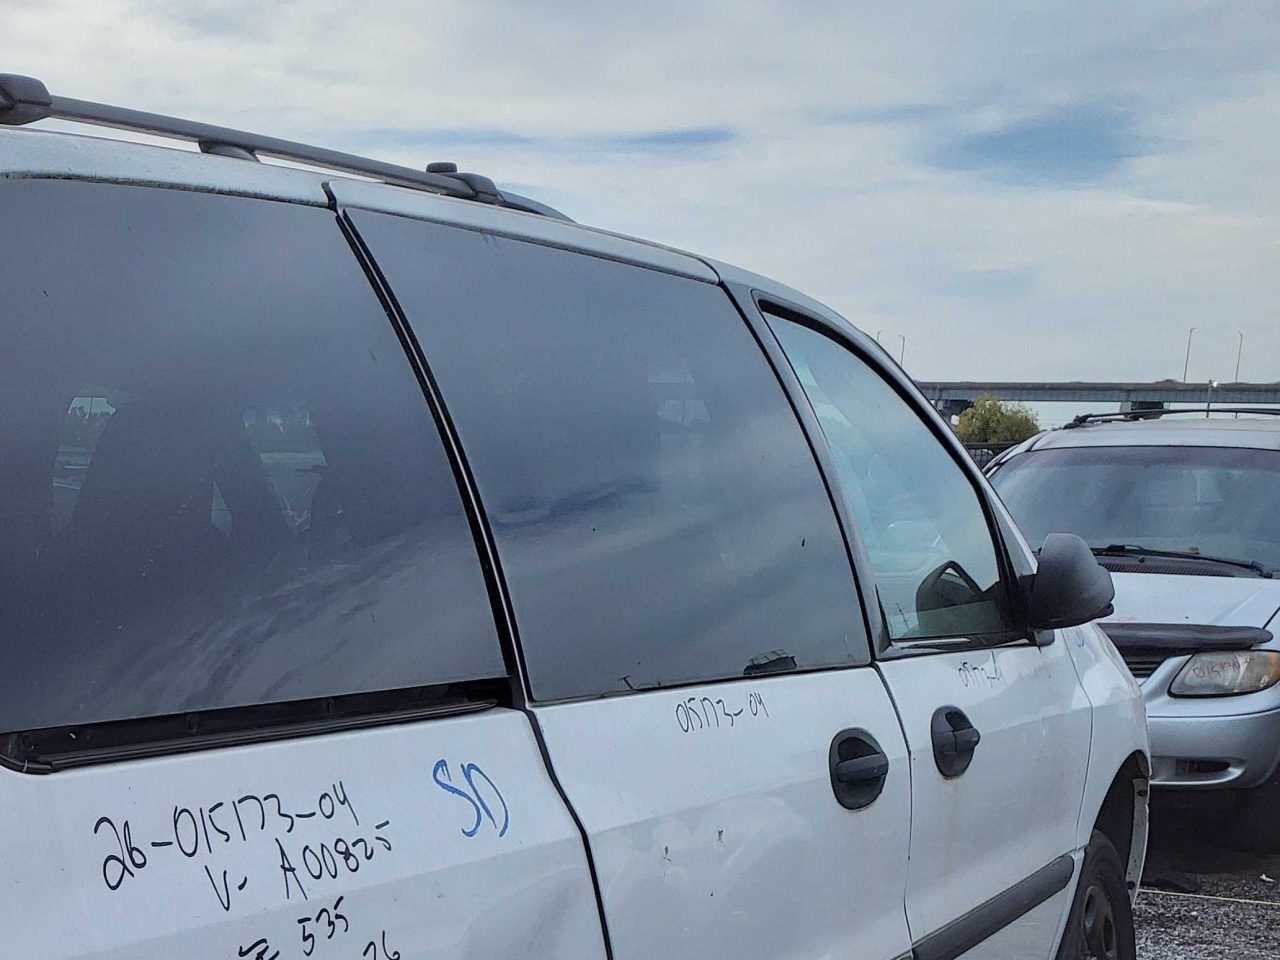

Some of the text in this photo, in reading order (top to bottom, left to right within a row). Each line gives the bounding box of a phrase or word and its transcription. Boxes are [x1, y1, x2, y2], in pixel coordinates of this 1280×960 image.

[431, 758, 511, 838] SD
[274, 819, 393, 901] A00825
[296, 895, 350, 957] 535
